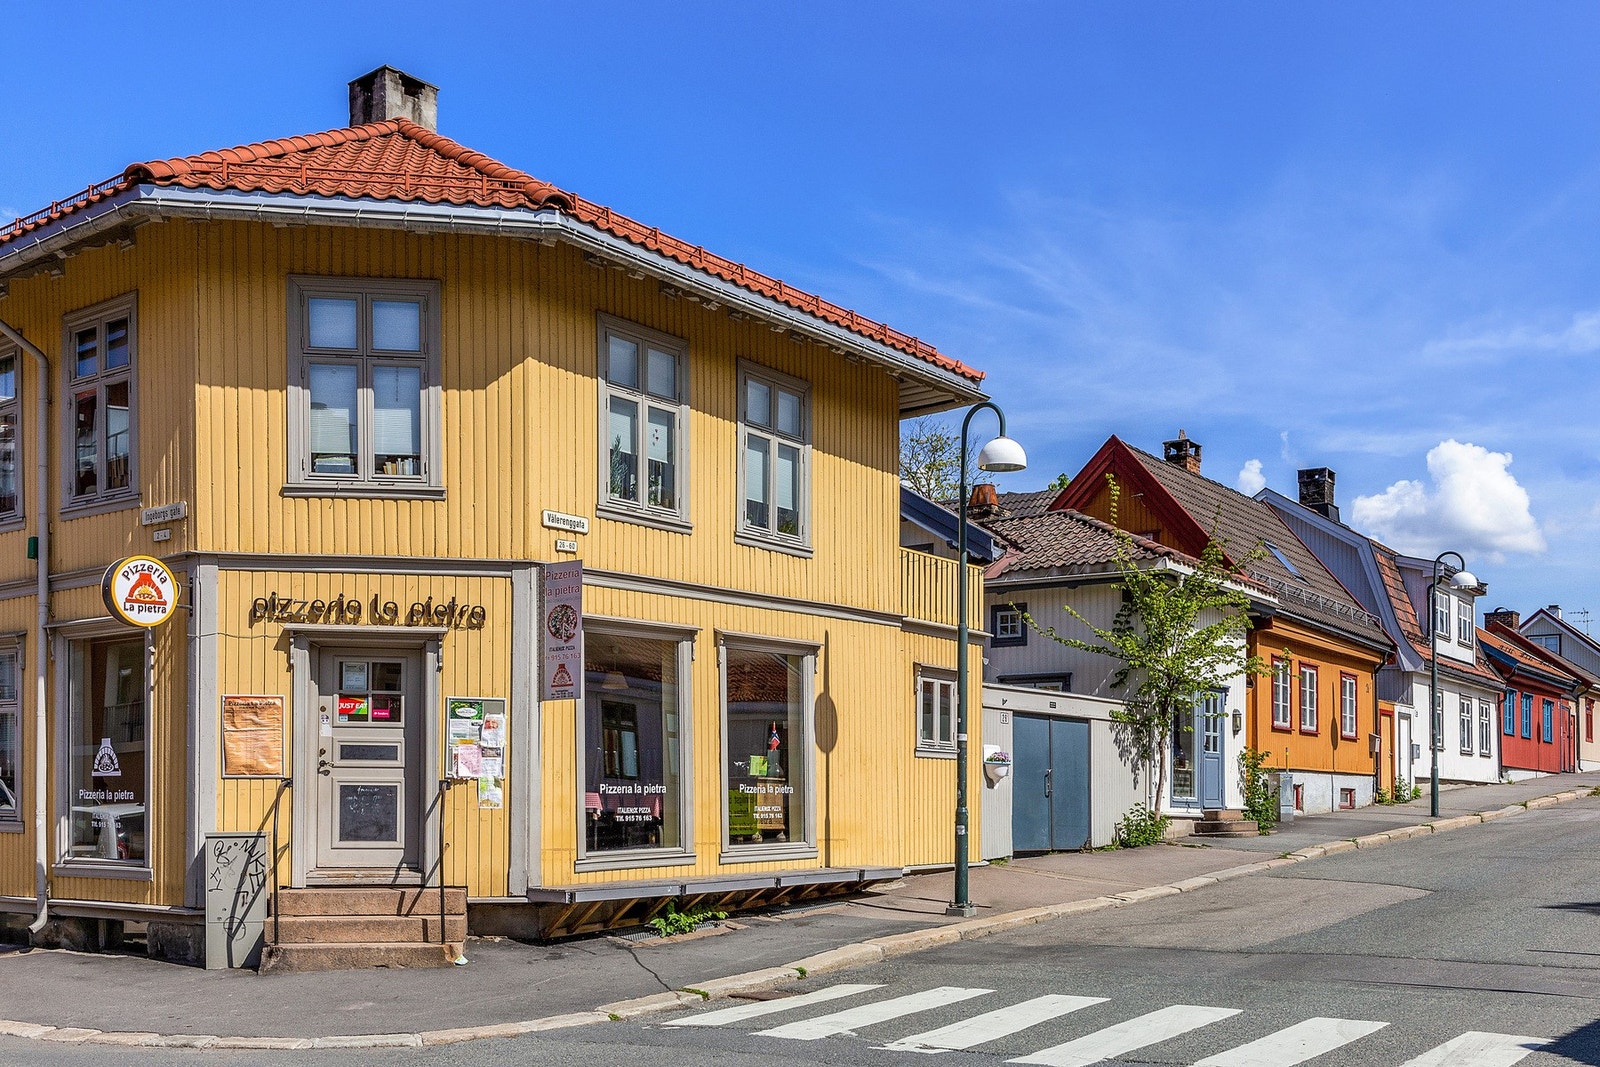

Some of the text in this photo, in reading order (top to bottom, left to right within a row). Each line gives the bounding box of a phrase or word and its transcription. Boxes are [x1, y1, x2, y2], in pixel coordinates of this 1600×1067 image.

[145, 506, 181, 522] Ingeborgs gate
[547, 512, 585, 530] Vålerenggata
[122, 563, 168, 584] Pizzeria
[545, 568, 580, 581] Pizzeria
[545, 584, 580, 599] la pietra
[123, 602, 167, 614] La pietra
[252, 591, 486, 623] pizzeria la pietra
[79, 788, 135, 803] Pizzeria la pietra
[600, 783, 667, 796] Pizzeria la pietra
[740, 783, 794, 796] Pizzeria la pietra
